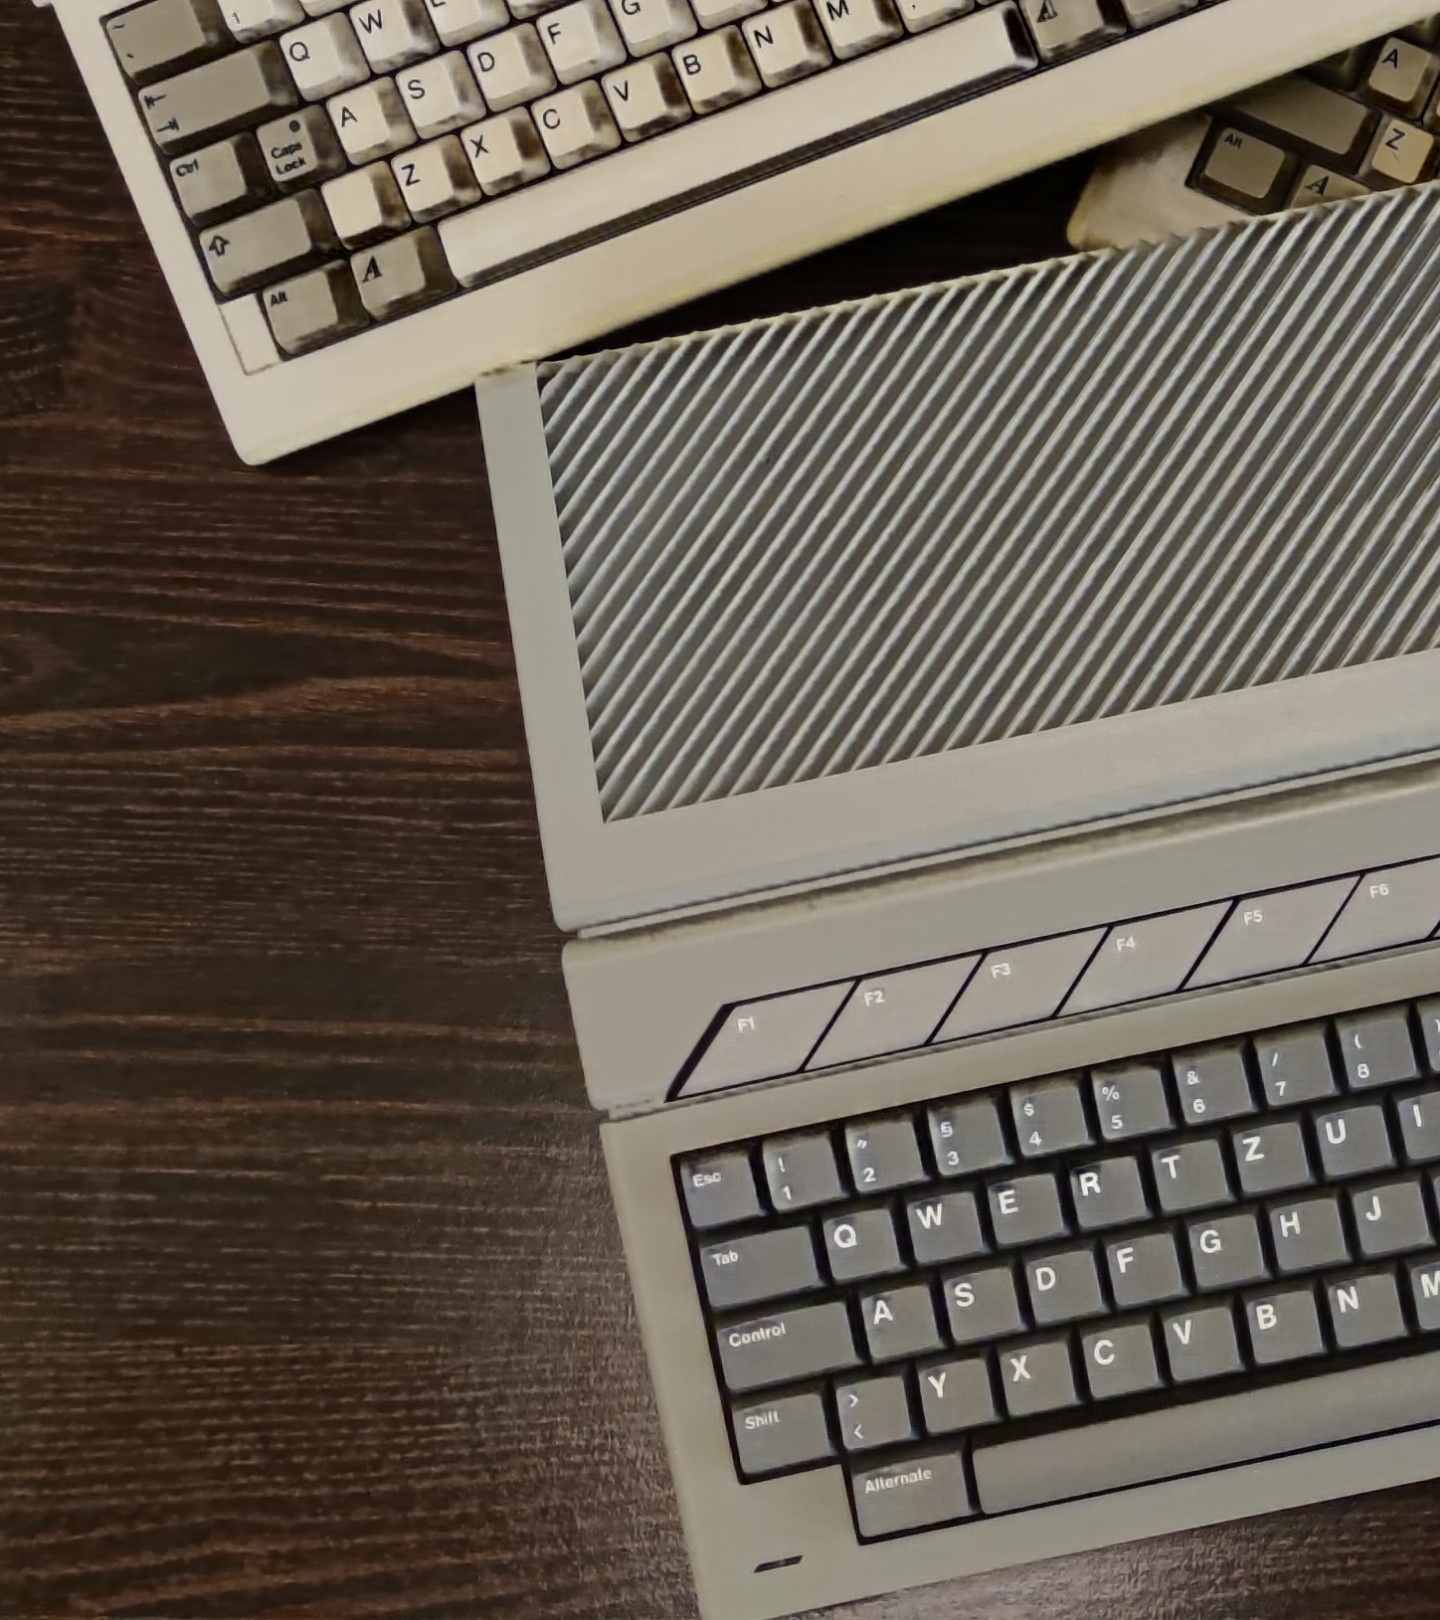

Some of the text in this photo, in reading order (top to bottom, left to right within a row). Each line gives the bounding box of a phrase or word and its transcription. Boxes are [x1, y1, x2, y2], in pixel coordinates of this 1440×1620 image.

[358, 9, 383, 34] W
[546, 22, 562, 45] F
[753, 25, 774, 49] N
[289, 41, 311, 62] Q
[476, 51, 495, 73] D
[682, 53, 702, 76] B
[407, 79, 426, 100] S
[613, 80, 629, 102] V
[341, 106, 358, 128] A
[542, 108, 561, 130] C
[469, 134, 489, 159] X
[400, 163, 421, 187] Z
[1369, 883, 1390, 899] F6
[1243, 909, 1263, 926] F5
[1116, 936, 1136, 953] F4
[990, 962, 1012, 979] F3
[863, 990, 885, 1007] F2
[737, 1016, 755, 1033] F1
[1412, 1104, 1422, 1128] I
[1325, 1118, 1346, 1145] U
[1242, 1136, 1265, 1162] Z
[1160, 1154, 1180, 1179] T
[692, 1172, 722, 1188] Esc
[1079, 1172, 1101, 1197] R
[998, 1189, 1019, 1215] E
[1365, 1195, 1382, 1221] J
[916, 1203, 943, 1229] W
[1279, 1211, 1301, 1238] H
[833, 1224, 857, 1249] Q
[1199, 1229, 1222, 1254] G
[711, 1249, 739, 1266] Tab
[1116, 1246, 1134, 1274] F
[1035, 1266, 1056, 1292] D
[954, 1282, 975, 1308] S
[1336, 1286, 1359, 1313] N
[873, 1300, 894, 1325] A
[1256, 1304, 1277, 1330] B
[728, 1322, 786, 1348] Control
[1172, 1319, 1192, 1345] V
[1093, 1339, 1115, 1365] C
[1010, 1355, 1032, 1382] X
[927, 1372, 946, 1398] Y
[744, 1410, 780, 1430] Shift
[865, 1467, 932, 1494] Alternate
